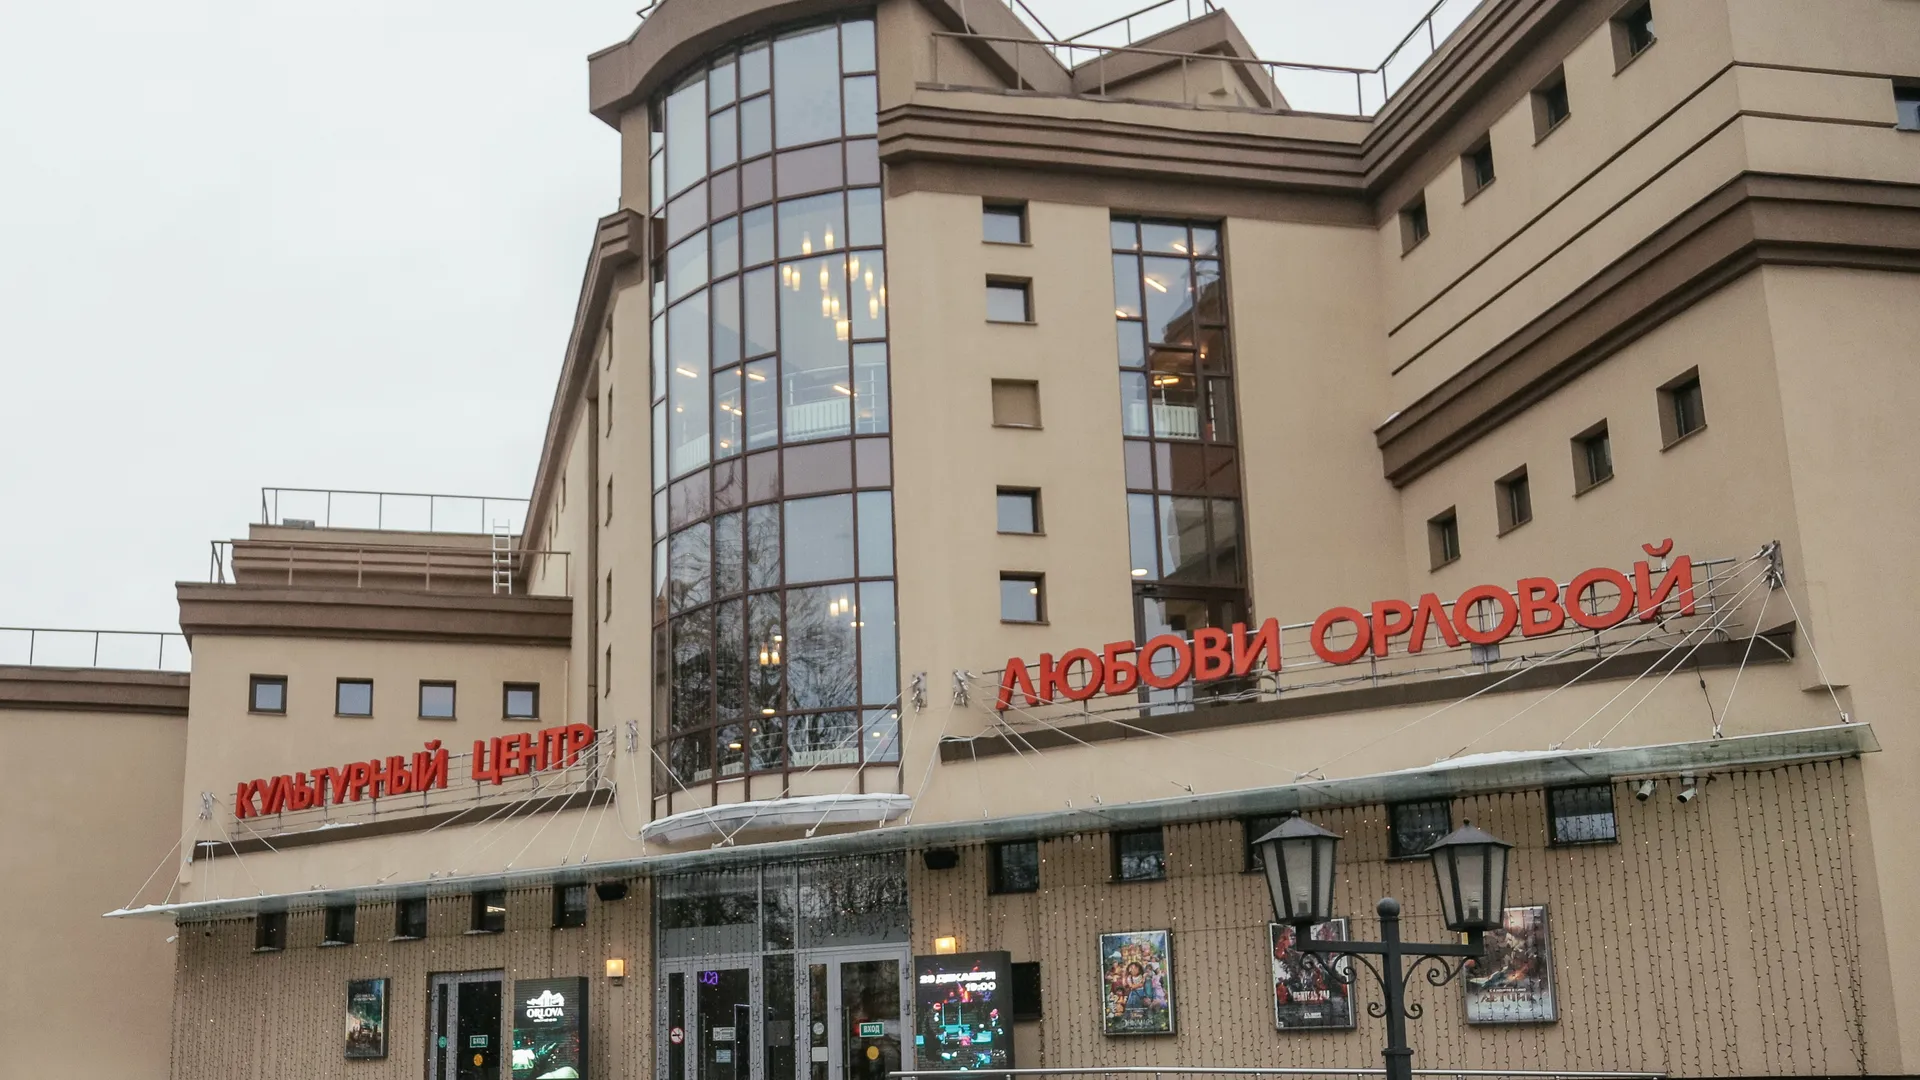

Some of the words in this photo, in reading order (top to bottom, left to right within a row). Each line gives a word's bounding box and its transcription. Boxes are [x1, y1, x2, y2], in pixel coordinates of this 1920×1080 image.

[995, 617, 1282, 710] ЛЮБОВИ
[1309, 538, 1695, 665] ОРЛОВОЙ
[235, 739, 449, 819] КУЛЬТУРНЫЙ
[472, 722, 595, 785] ЦЕНТР
[526, 1007, 564, 1019] ORLOVA
[863, 1024, 880, 1033] ВХОД
